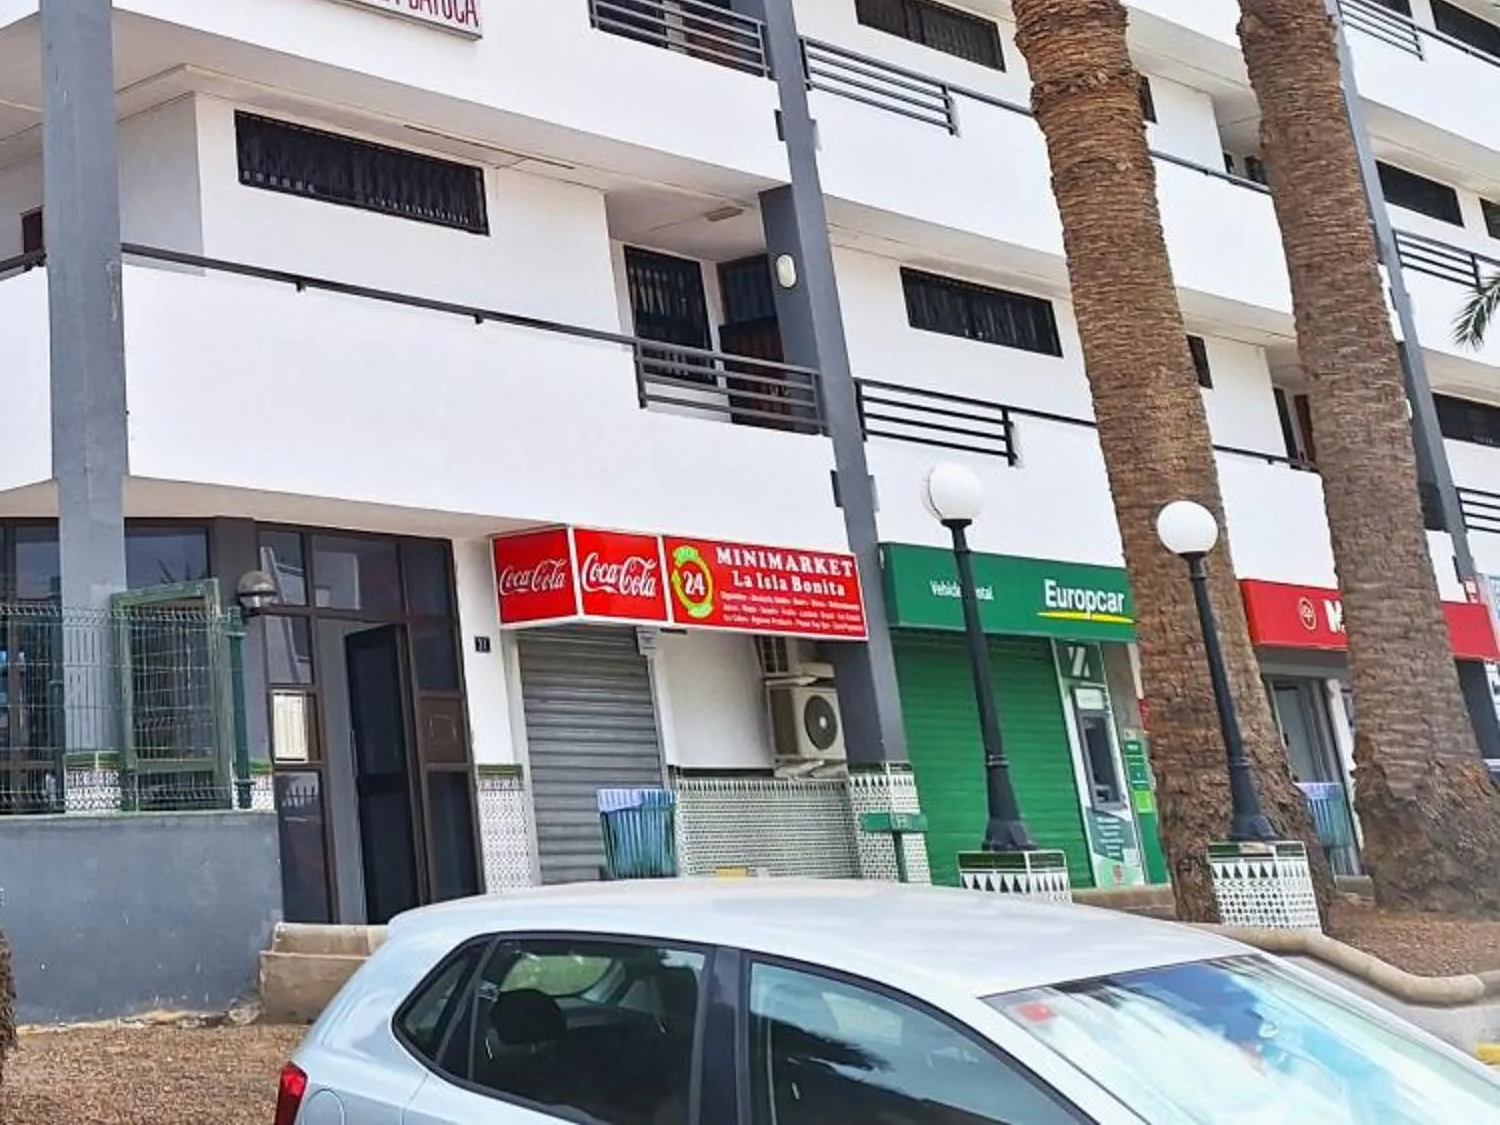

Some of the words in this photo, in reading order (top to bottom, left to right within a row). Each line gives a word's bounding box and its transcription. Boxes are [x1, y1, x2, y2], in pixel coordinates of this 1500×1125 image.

[715, 546, 853, 578] MINIMARKET
[683, 570, 706, 596] 24
[731, 570, 753, 588] La
[756, 572, 789, 591] Isla
[791, 575, 846, 596] Bonita
[1044, 578, 1125, 616] Europcar
